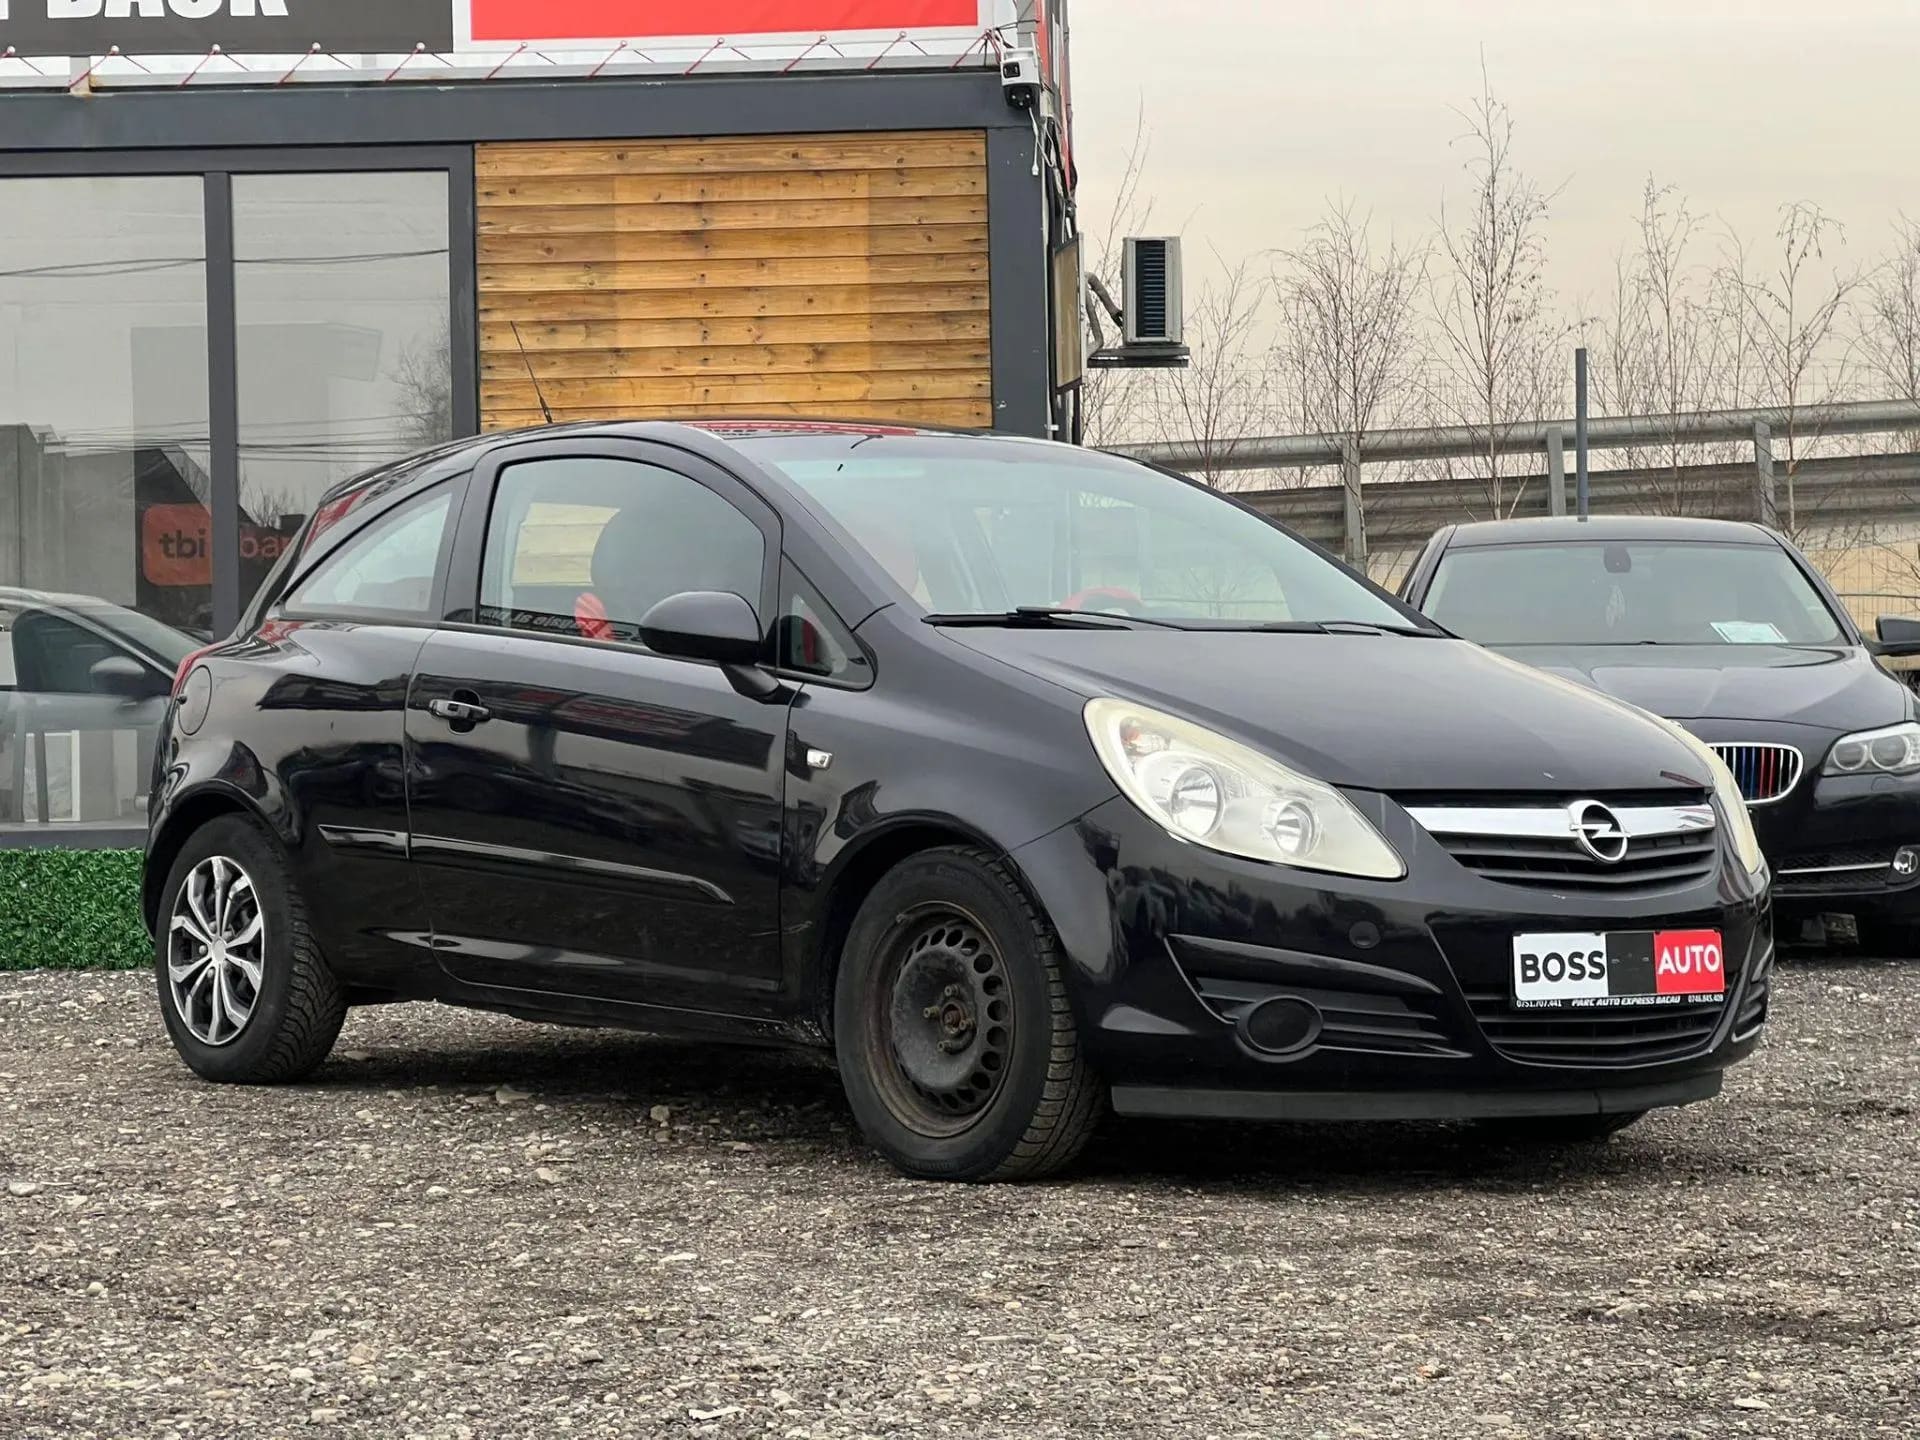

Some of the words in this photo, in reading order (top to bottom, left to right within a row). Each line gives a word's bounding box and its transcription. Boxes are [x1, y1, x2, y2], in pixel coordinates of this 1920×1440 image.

[159, 527, 206, 559] tbi
[1520, 951, 1606, 984] BOSS
[1657, 944, 1720, 976] AUTO
[1571, 999, 1596, 1007] PARC
[1596, 998, 1620, 1007] AUTO
[1621, 996, 1655, 1006] EXPRESS
